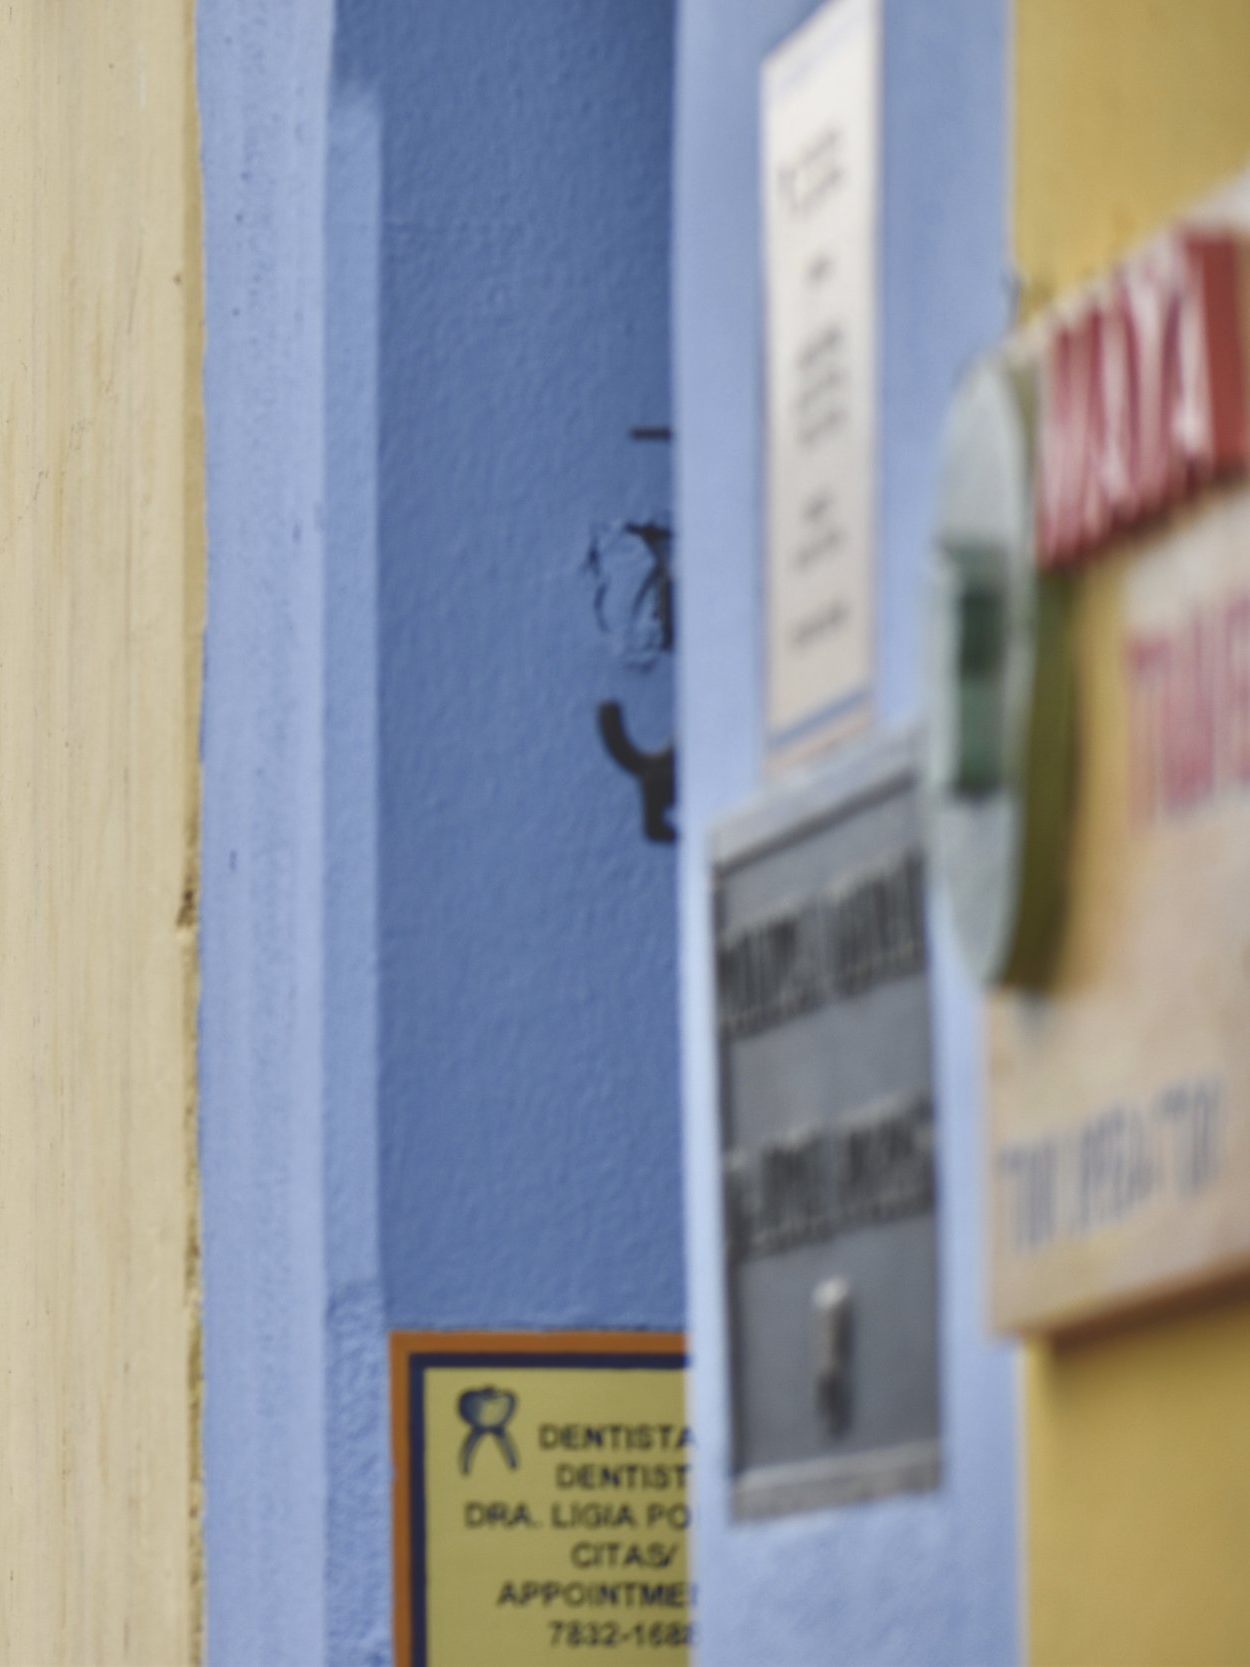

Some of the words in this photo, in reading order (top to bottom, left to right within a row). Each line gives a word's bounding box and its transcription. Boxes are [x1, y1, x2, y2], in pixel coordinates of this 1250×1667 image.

[539, 1424, 699, 1450] DENTISTA
[556, 1464, 692, 1490] DENTIST
[464, 1503, 541, 1529] DRA.
[550, 1503, 636, 1529] LIGIA
[570, 1541, 679, 1568] CITAS/
